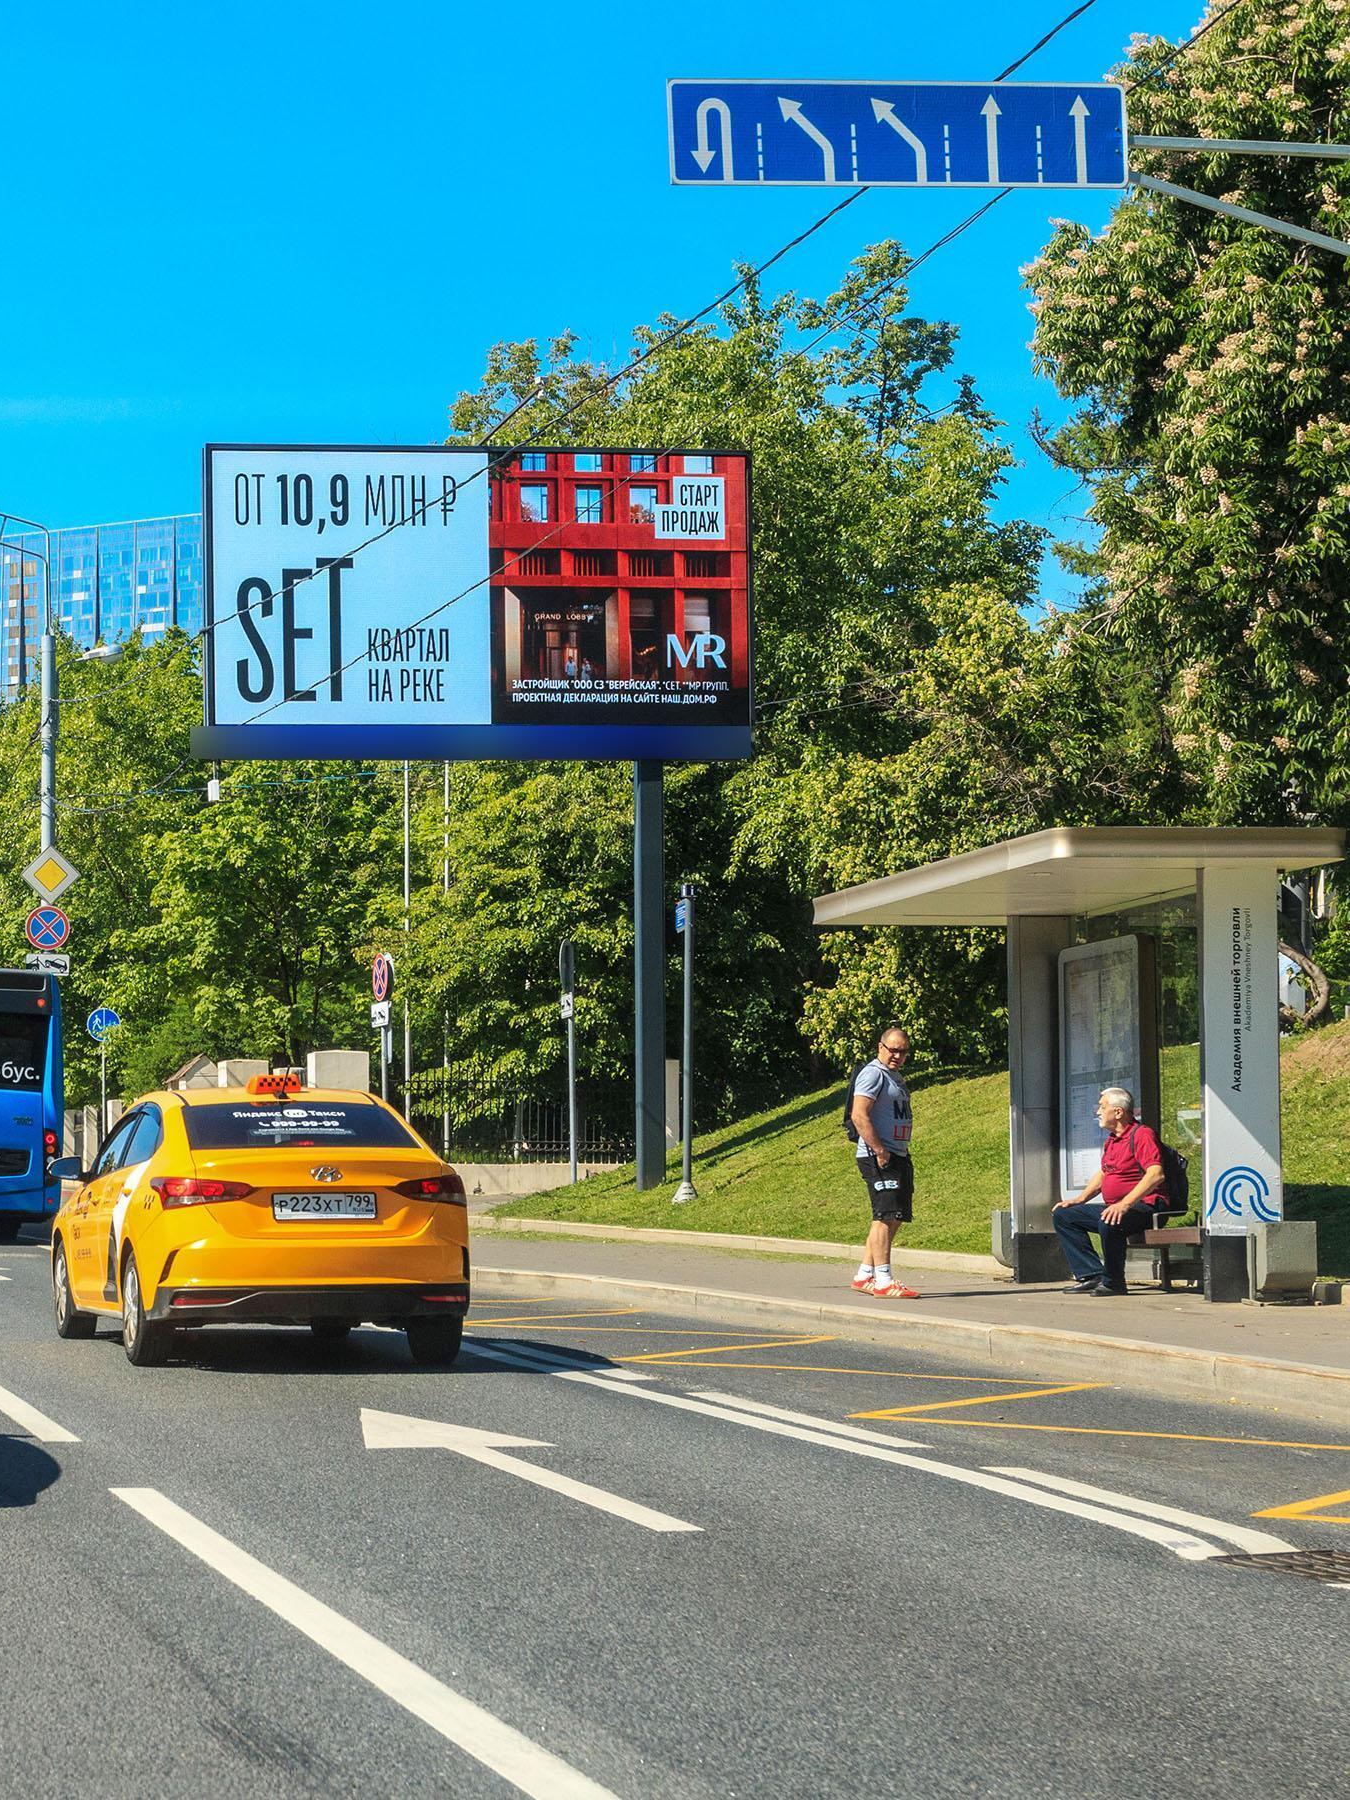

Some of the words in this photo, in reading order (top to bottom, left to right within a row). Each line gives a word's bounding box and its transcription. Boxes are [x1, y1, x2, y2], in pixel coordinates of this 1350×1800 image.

[234, 473, 266, 526] ОТ
[276, 473, 350, 535] 10,9
[364, 475, 426, 526] МЛН
[680, 484, 719, 506] СТАРТ
[662, 510, 719, 535] ПРОДАЖ
[236, 557, 354, 703] SET
[534, 613, 561, 621] GRAND
[367, 628, 450, 662] КВАРТАЛ
[666, 634, 727, 668] MR
[368, 669, 393, 702] НА
[400, 669, 445, 702] РЕКЕ
[512, 678, 569, 690] ЗАСТРОЙЩИК
[512, 693, 562, 703] ПРОЕКТНАЯ
[563, 693, 619, 704] ДЕКЛАРАЦИЯ
[620, 694, 633, 703] НА
[633, 693, 660, 704] САЙТЕ
[1232, 907, 1242, 966] торговли
[1243, 908, 1252, 941] Torgovli
[1243, 943, 1252, 983] Vneshney
[1230, 968, 1241, 1025] внешней
[1243, 984, 1252, 1032] Akademiya
[1230, 1028, 1242, 1092] Академия
[279, 1196, 343, 1212] Р223ХТ
[346, 1195, 370, 1207] 799
